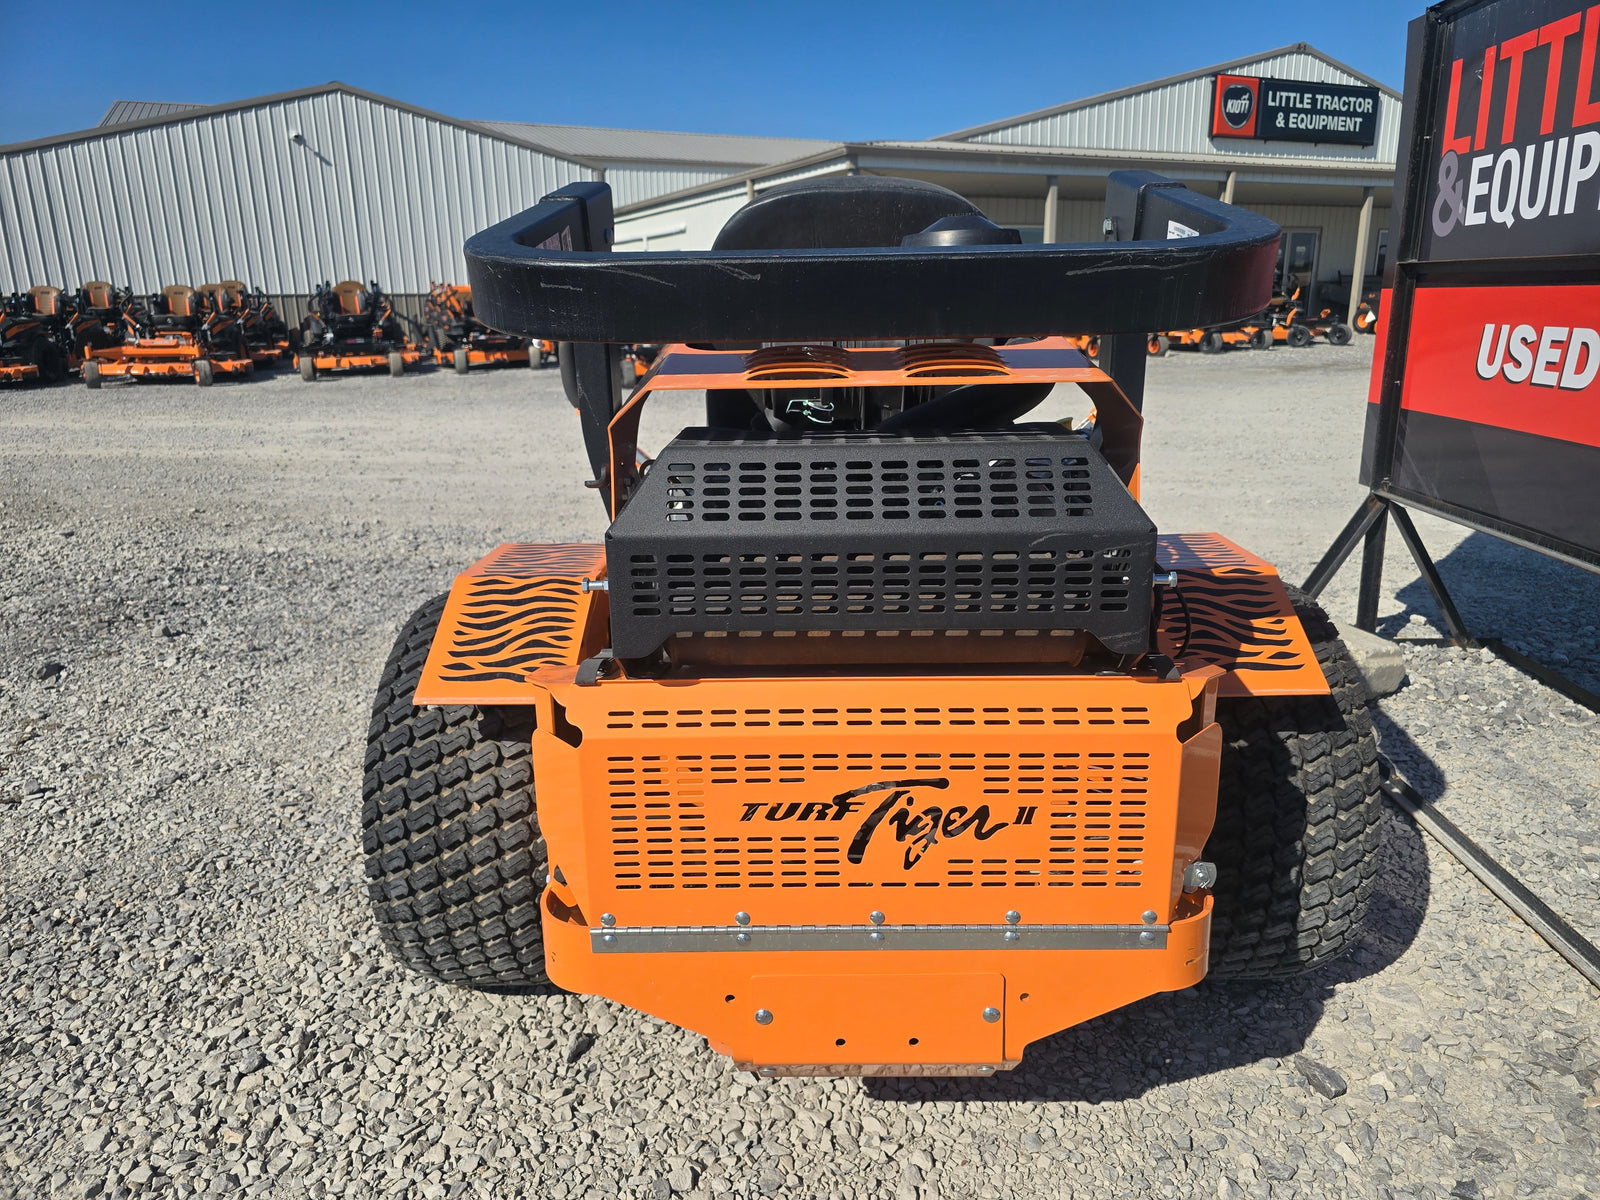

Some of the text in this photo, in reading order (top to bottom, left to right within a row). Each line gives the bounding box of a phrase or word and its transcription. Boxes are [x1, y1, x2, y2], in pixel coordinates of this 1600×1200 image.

[1267, 90, 1373, 114] LITTLE TRACTOR
[1275, 112, 1363, 132] & EQUIPMENT
[1432, 130, 1600, 238] & EQUIP
[1475, 323, 1600, 392] USED
[739, 801, 866, 822] TURF
[832, 777, 1009, 871] Tiger
